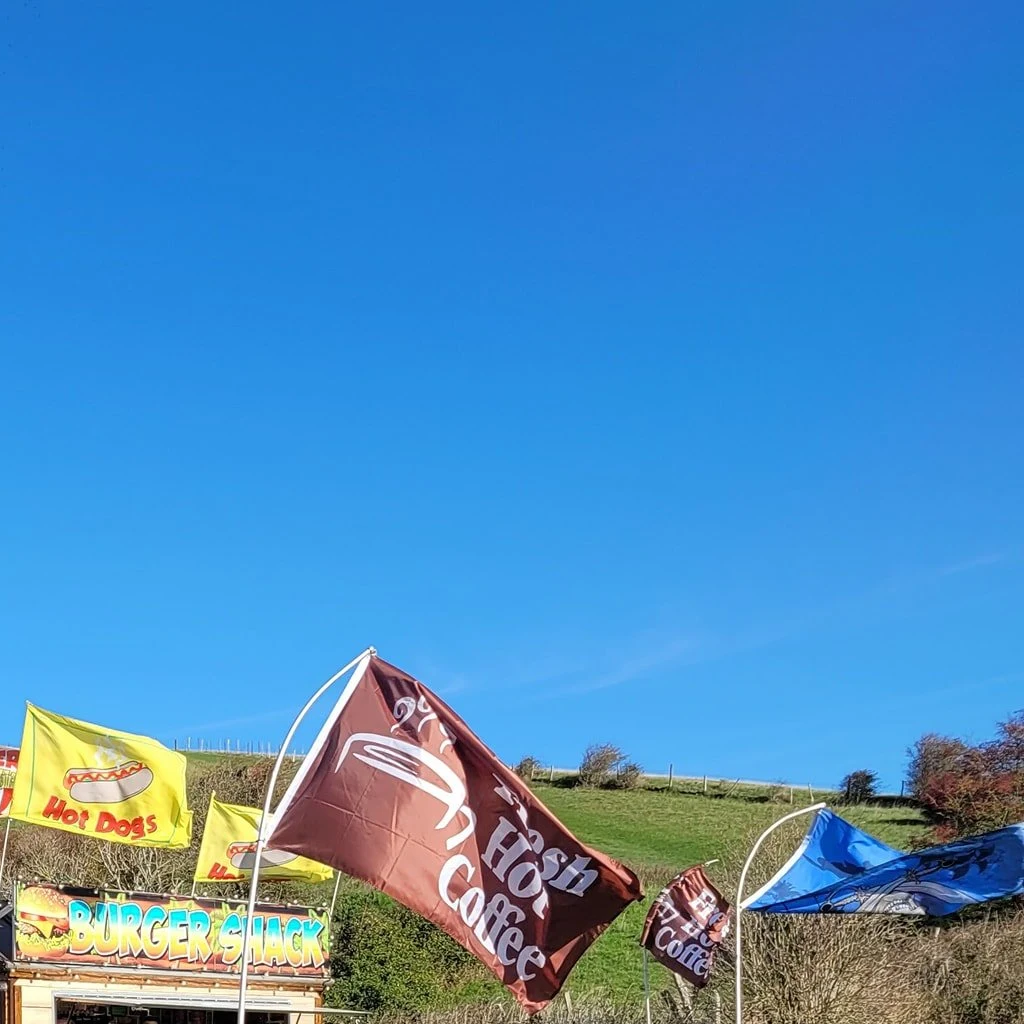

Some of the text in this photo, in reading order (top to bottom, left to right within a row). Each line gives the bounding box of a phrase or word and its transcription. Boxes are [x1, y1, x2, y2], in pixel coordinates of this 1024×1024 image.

[42, 795, 158, 840] Hot Dogs
[68, 899, 325, 968] BURGER SHACK
[438, 854, 546, 981] Coffee
[654, 926, 711, 979] Coffe
